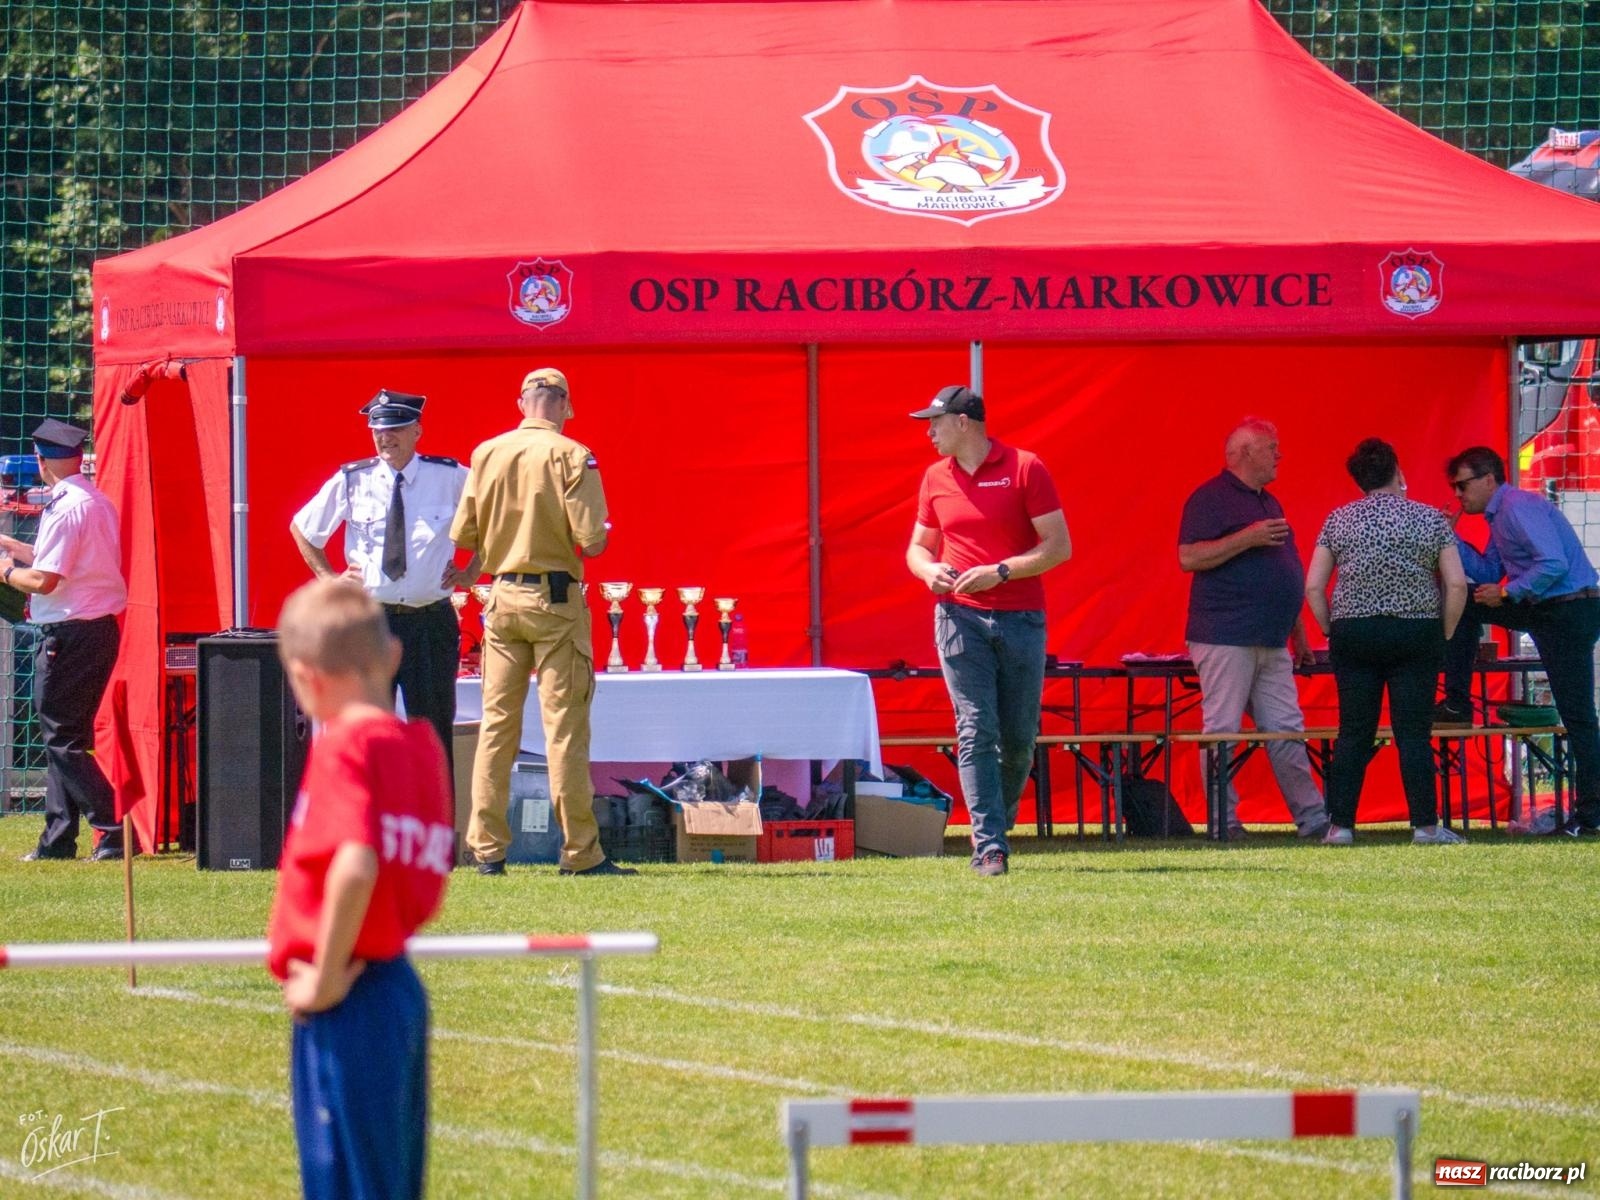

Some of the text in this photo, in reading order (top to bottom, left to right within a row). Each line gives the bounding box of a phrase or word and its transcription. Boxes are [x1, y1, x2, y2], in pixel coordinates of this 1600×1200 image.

[851, 91, 998, 120] OSP
[917, 201, 1007, 209] MARKOWICE
[1391, 255, 1430, 267] OSP
[520, 263, 560, 278] OSP
[629, 268, 1333, 313] OSP RACIBÓRZ-MARKOWICE
